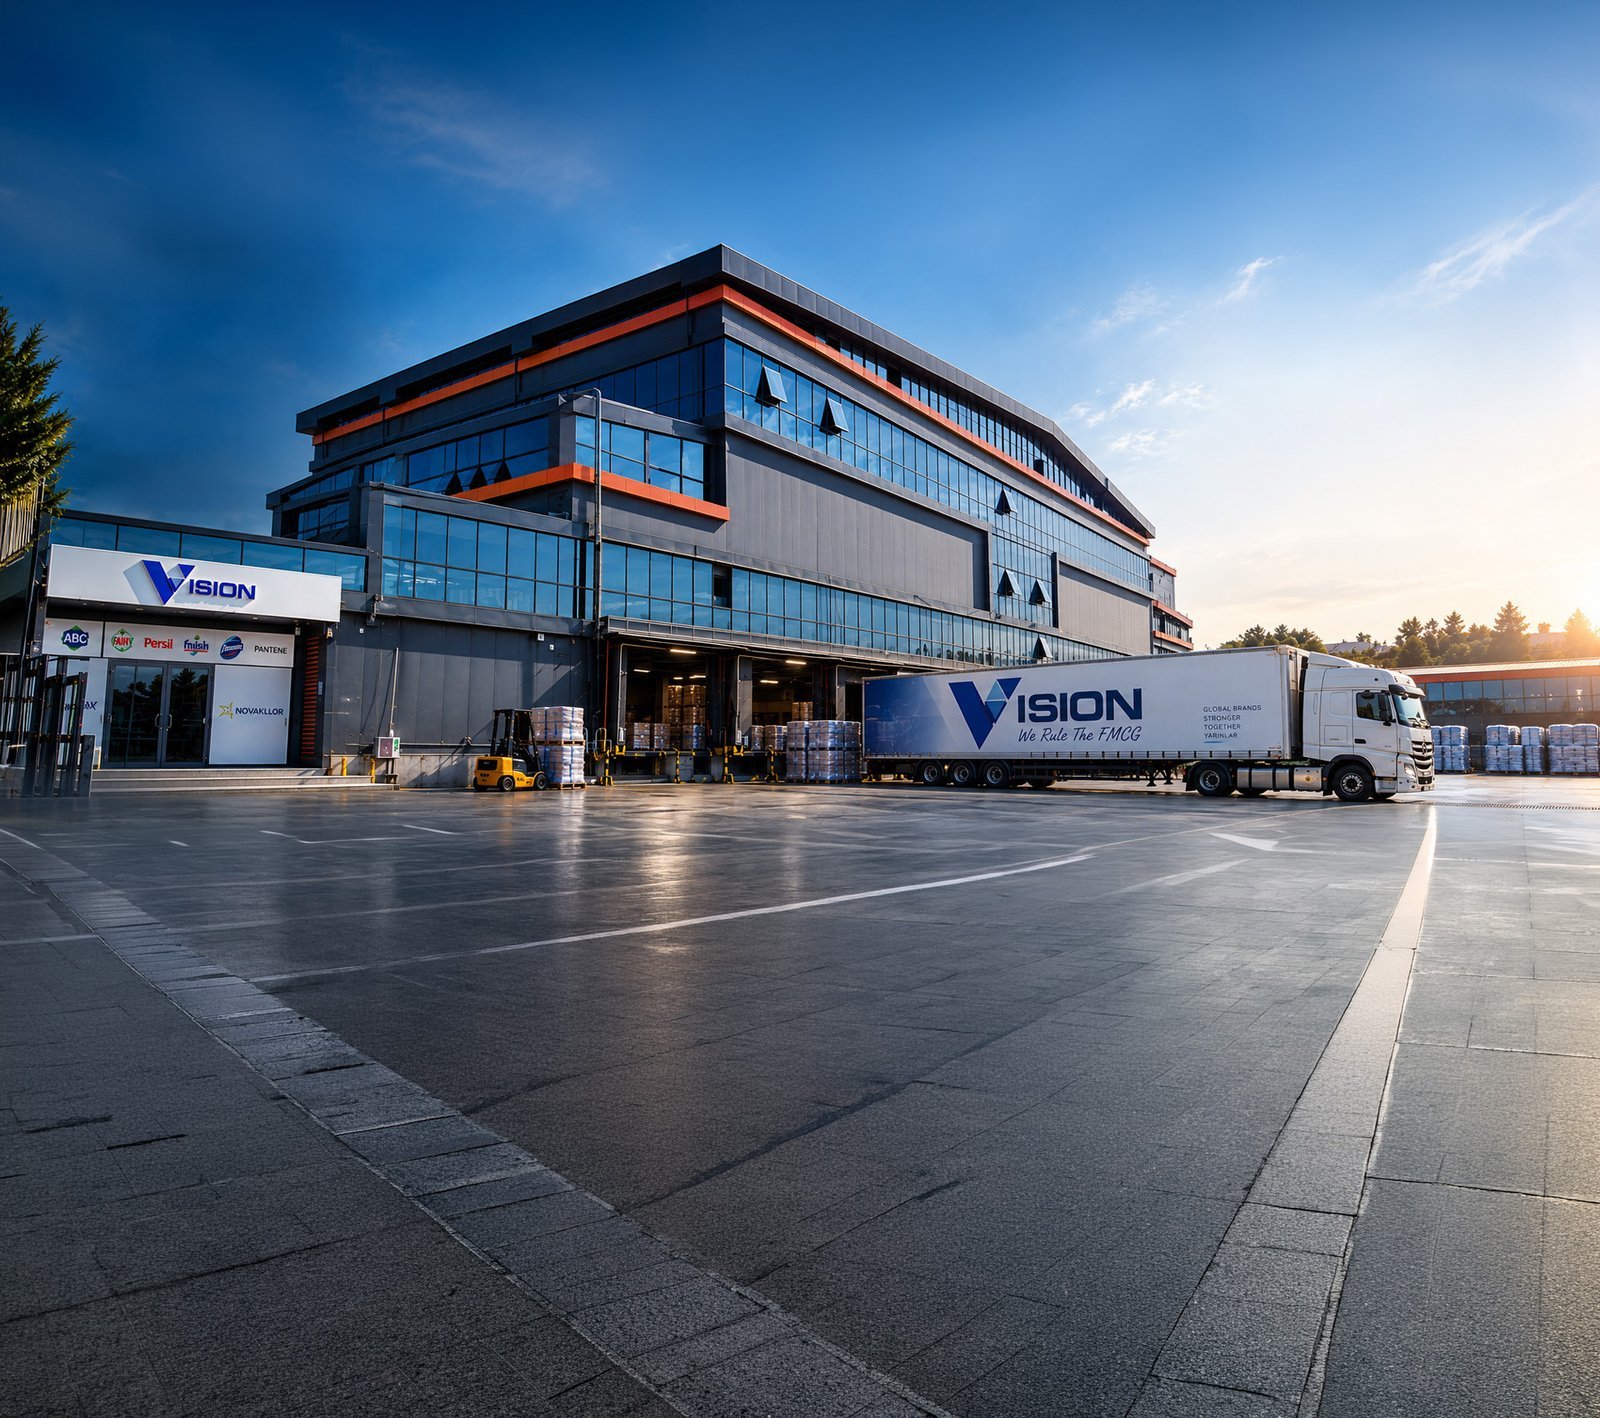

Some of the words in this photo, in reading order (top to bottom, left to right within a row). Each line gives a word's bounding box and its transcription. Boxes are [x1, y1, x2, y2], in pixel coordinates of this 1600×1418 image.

[142, 559, 256, 605] VISION
[63, 633, 88, 644] ABC
[143, 637, 173, 649] Persil
[254, 645, 288, 654] PANTENE
[235, 707, 284, 716] NOVAKLLOR
[948, 677, 1142, 750] VISION
[1203, 705, 1231, 713] GLOBAL
[1233, 704, 1262, 712] BRANDS
[1203, 714, 1241, 722] STRONGER
[1203, 723, 1241, 731] TOGETHER
[1018, 728, 1036, 743] We
[1040, 727, 1068, 742] Rule
[1073, 726, 1094, 741] The
[1097, 725, 1142, 743] FMCG
